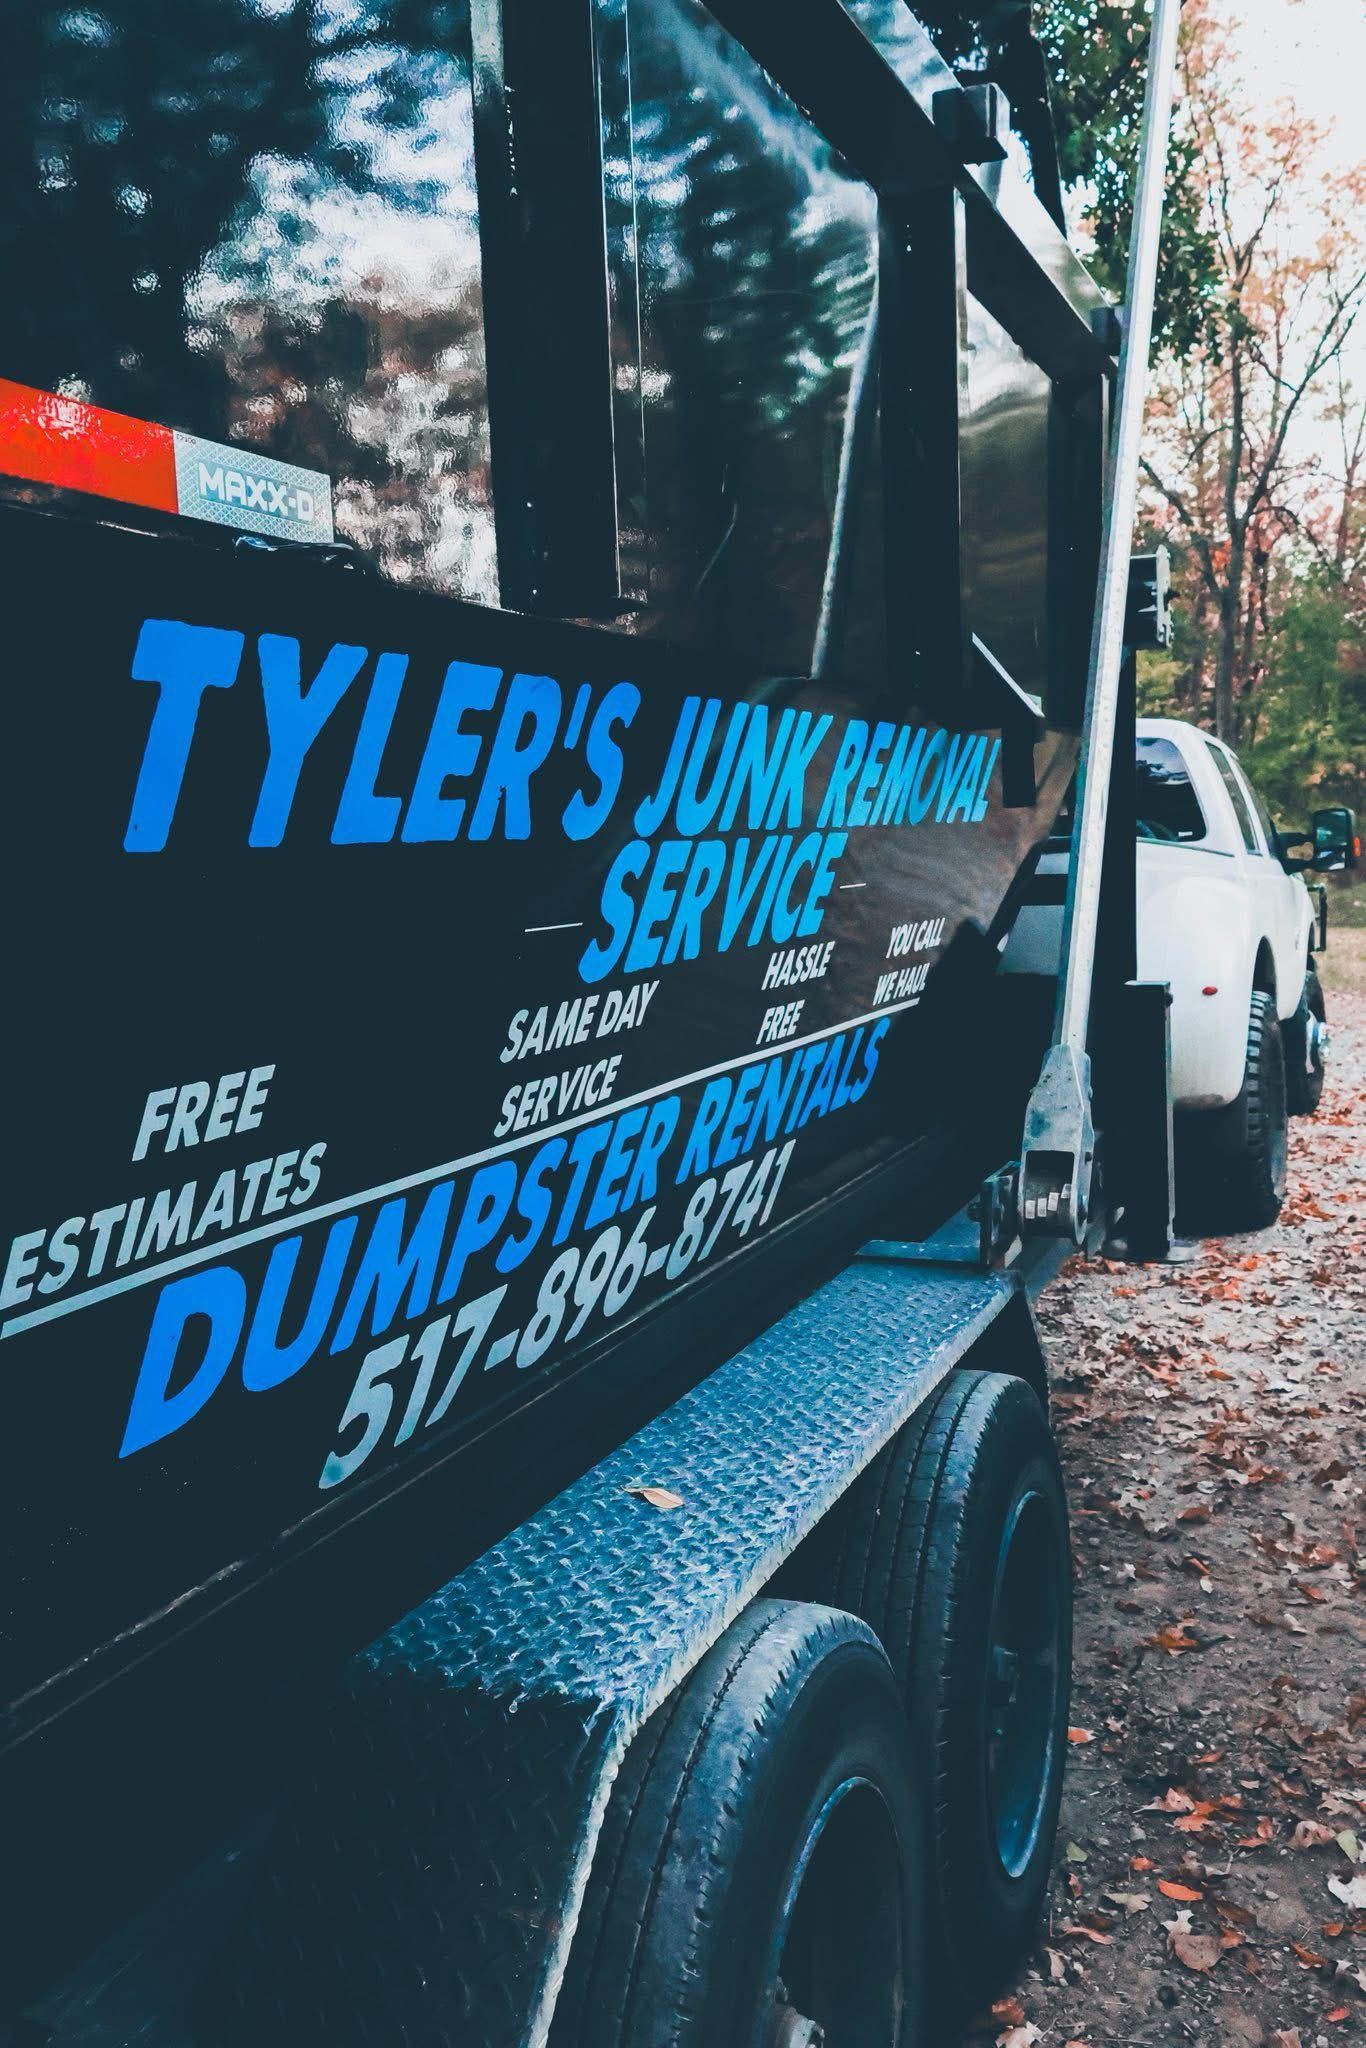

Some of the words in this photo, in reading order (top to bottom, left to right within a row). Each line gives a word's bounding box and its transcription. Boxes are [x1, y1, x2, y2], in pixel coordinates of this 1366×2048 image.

[198, 462, 315, 523] MAXX-D
[122, 618, 642, 853] TYLER'S
[633, 695, 834, 838] JUNK
[817, 718, 1003, 830] REMOVAL
[578, 829, 849, 984] SERVICE
[886, 922, 919, 959] YOU
[914, 917, 946, 953] CALL
[762, 940, 836, 991] HASSLE
[873, 970, 899, 1007] WE
[893, 962, 931, 999] HAUL
[500, 992, 594, 1063] SAME
[597, 980, 660, 1028] DAY
[756, 1000, 806, 1045] FREE
[131, 1064, 276, 1162] FREE
[493, 1055, 623, 1138] SERVICE
[0, 1142, 327, 1311] ESTIMATES
[118, 1095, 682, 1459] DUMPSTER
[674, 1016, 892, 1186] RENTALS
[318, 1138, 797, 1490] 517-896-8741
